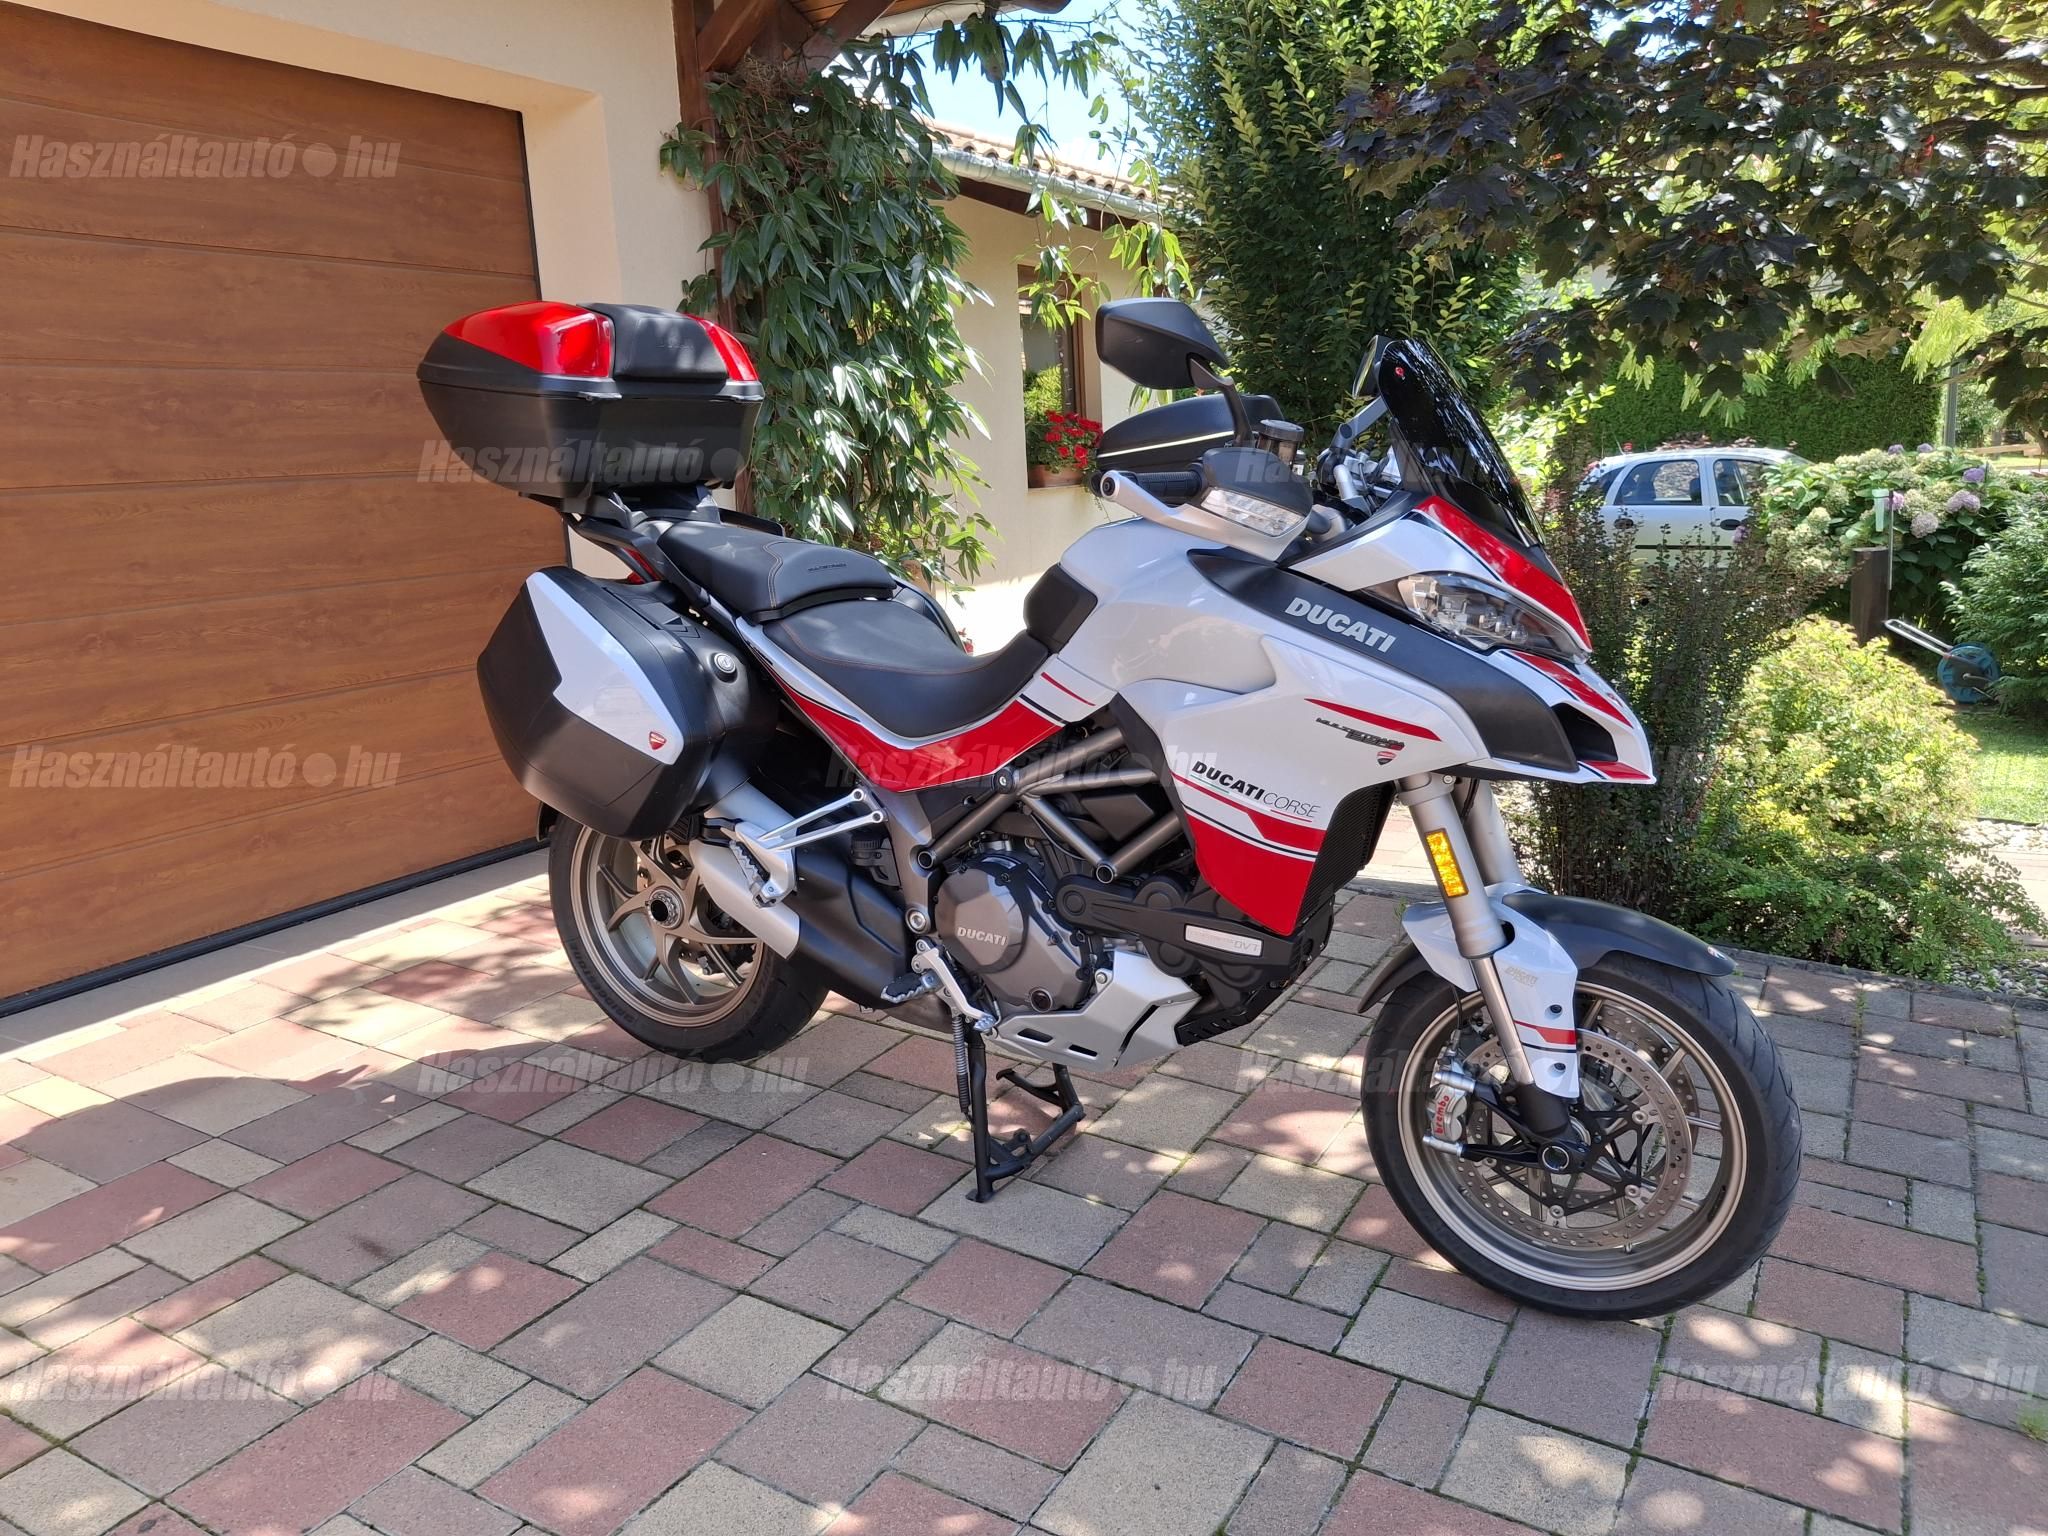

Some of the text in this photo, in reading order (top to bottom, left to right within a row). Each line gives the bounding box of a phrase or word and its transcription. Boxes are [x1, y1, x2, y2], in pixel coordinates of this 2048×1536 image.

[1285, 597, 1397, 653] DUCATI
[1191, 761, 1321, 818] DUCATI CORSE
[957, 926, 1008, 946] DUCATI
[1434, 1095, 1450, 1134] brembo
